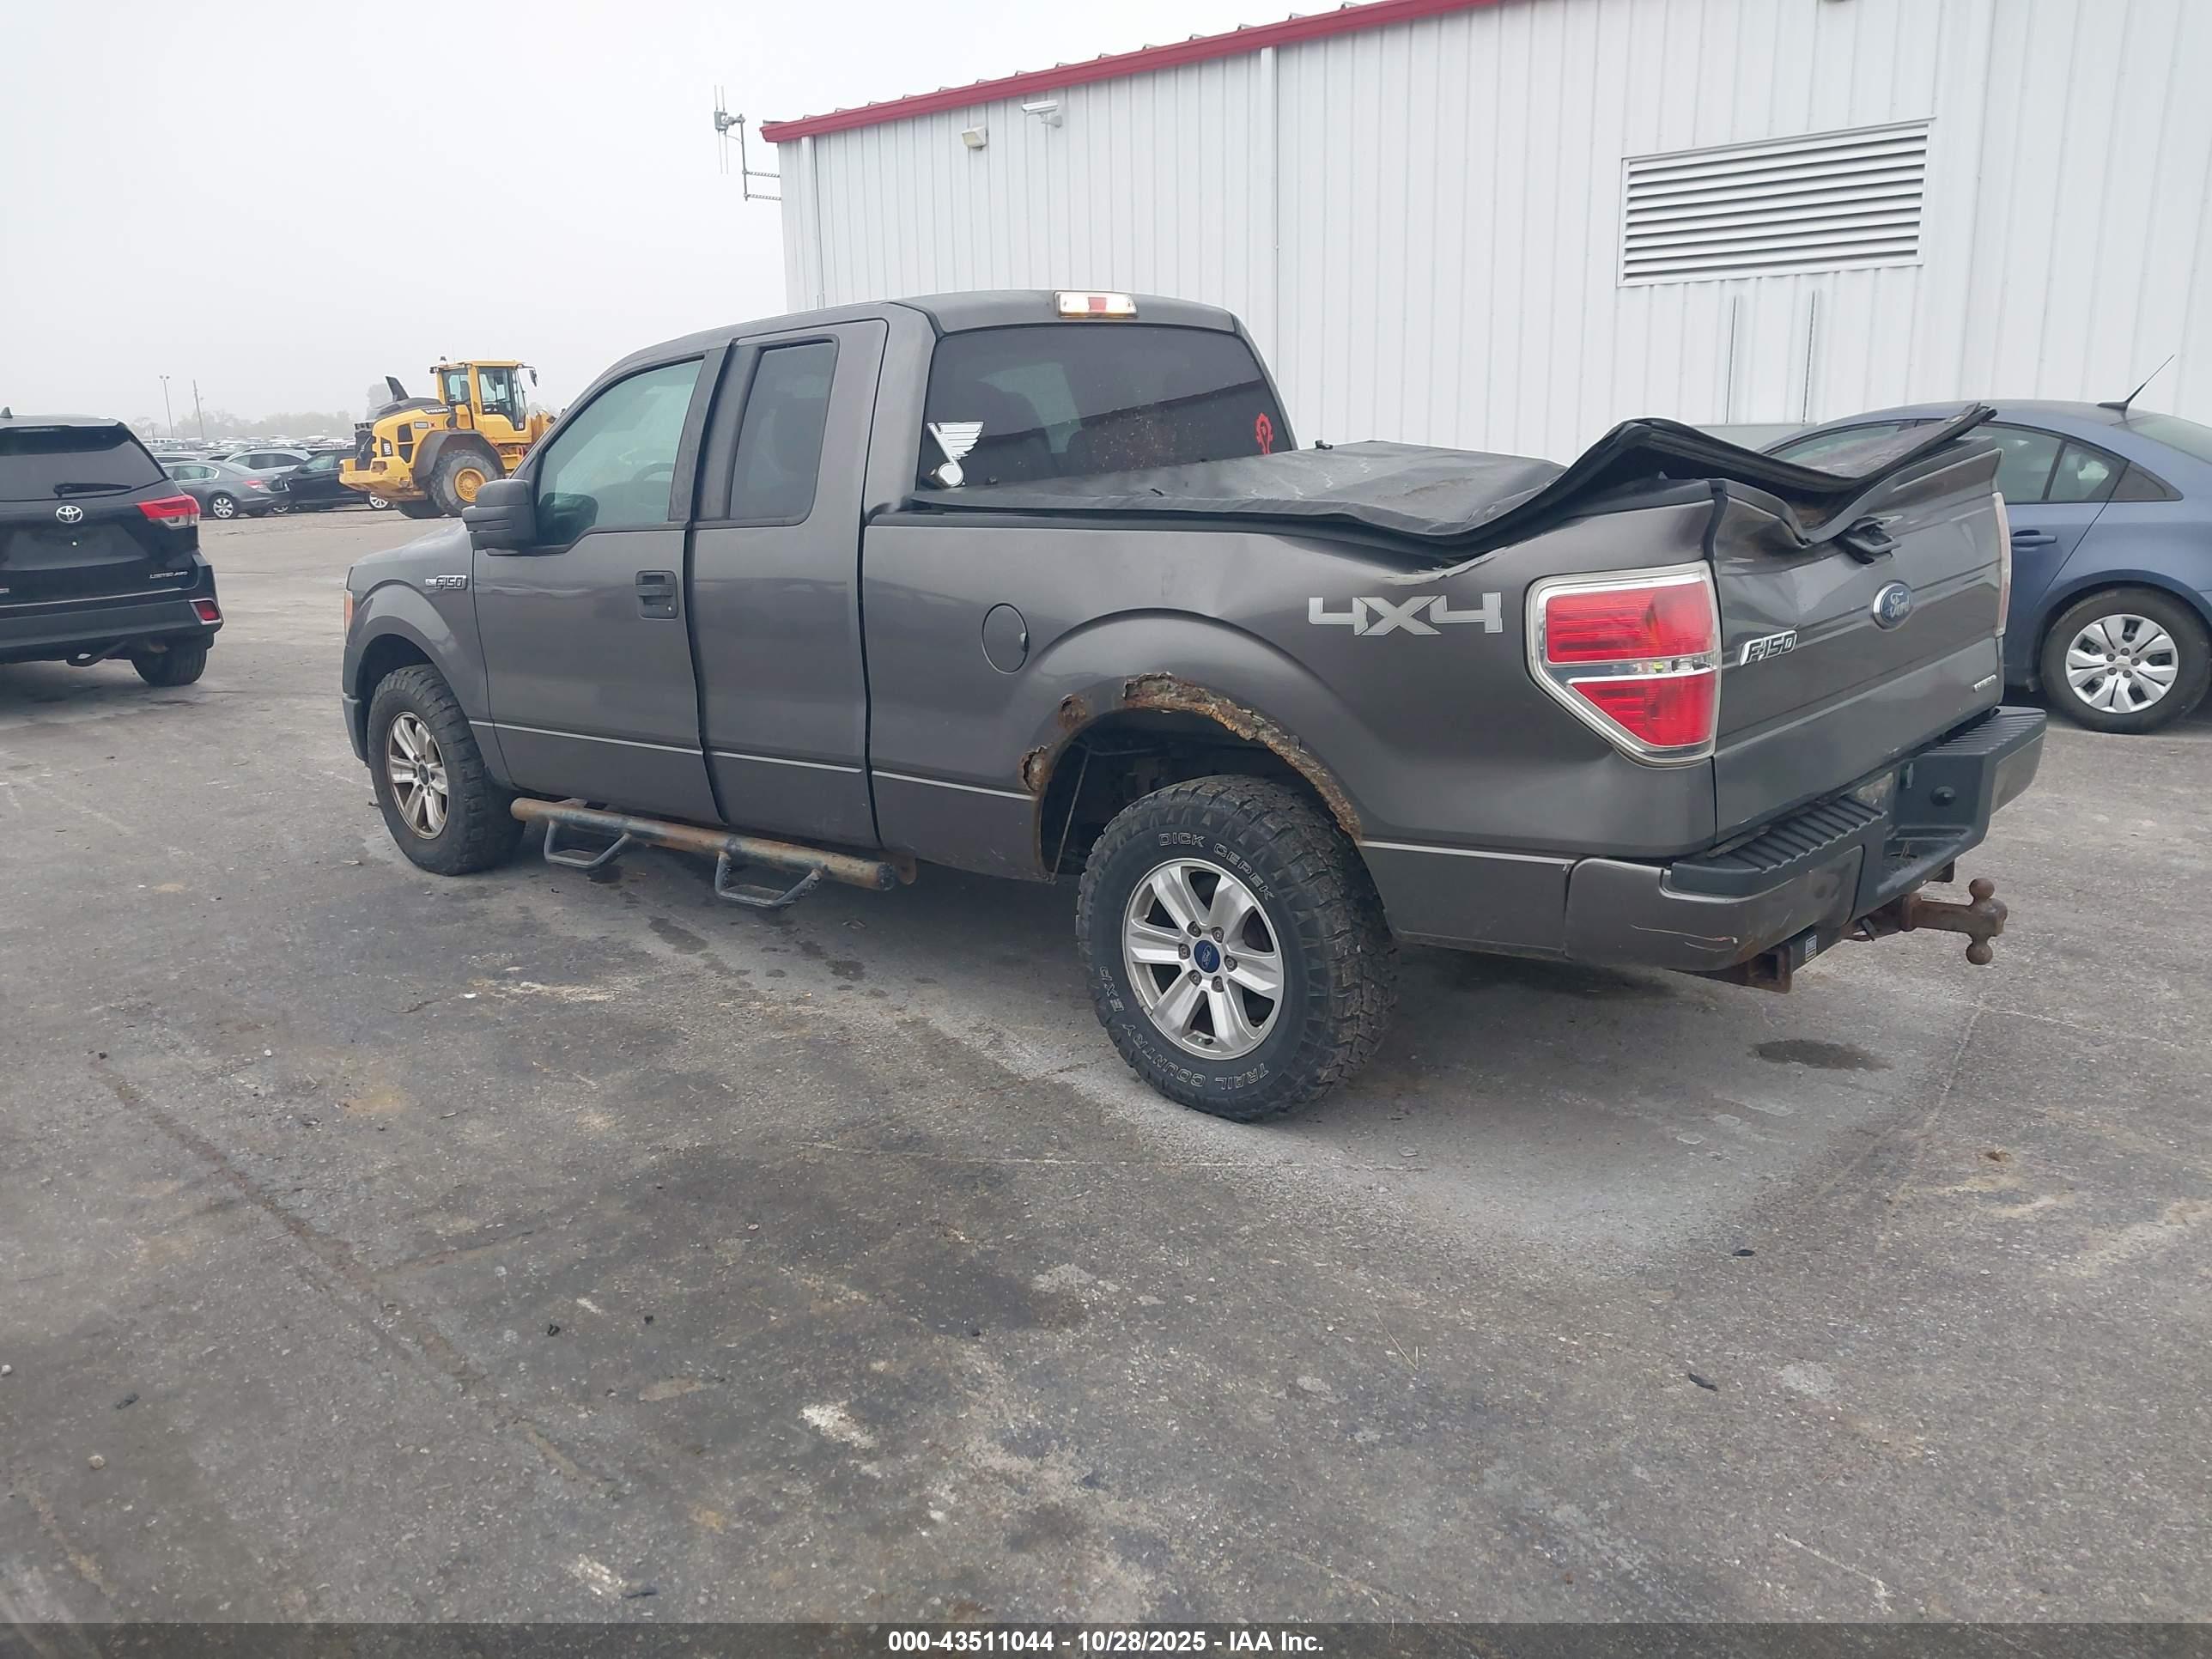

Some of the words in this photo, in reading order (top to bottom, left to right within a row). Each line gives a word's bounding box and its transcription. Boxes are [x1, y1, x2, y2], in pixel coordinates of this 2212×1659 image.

[1887, 591, 1911, 618] Ford
[1159, 831, 1206, 848] DICK
[1213, 842, 1275, 901] CEPEK
[1099, 965, 1125, 1012] EXP
[1121, 1024, 1206, 1088] COUNTRY
[1215, 1062, 1270, 1091] TRAIL
